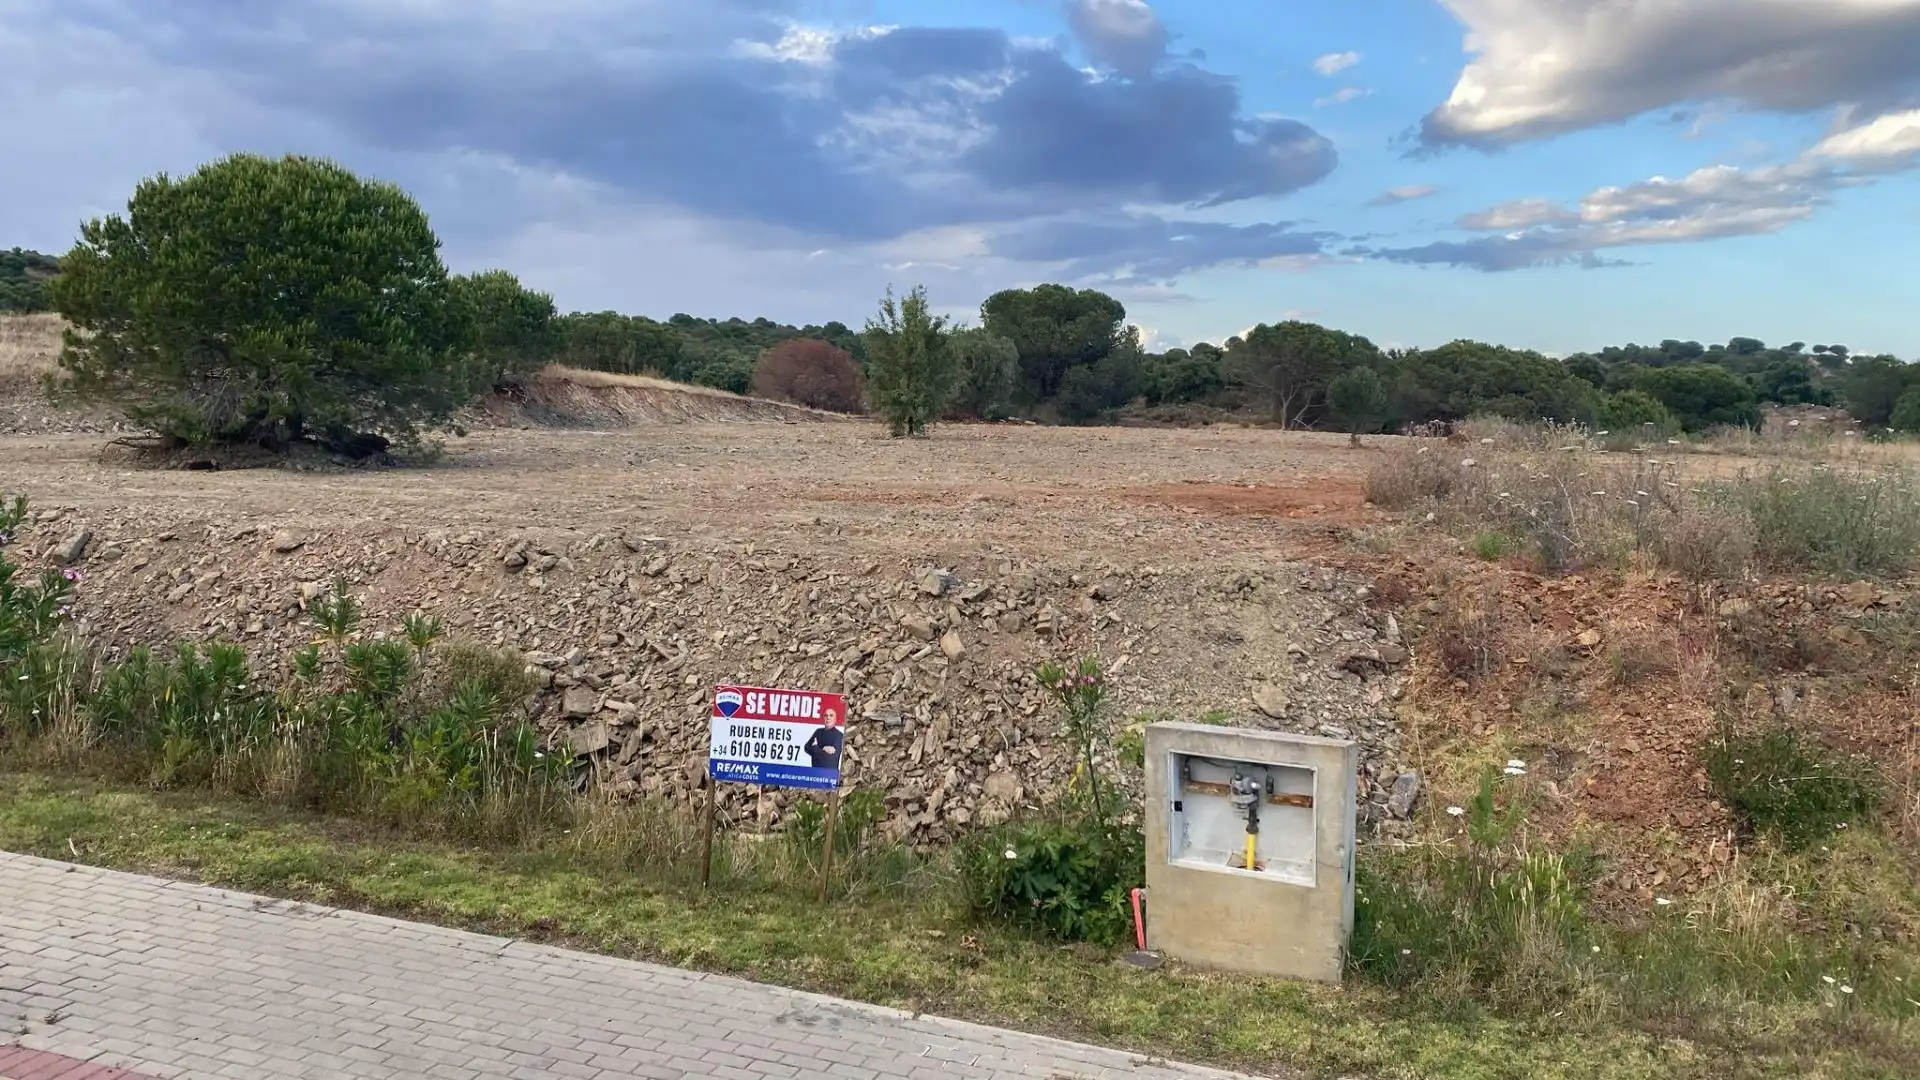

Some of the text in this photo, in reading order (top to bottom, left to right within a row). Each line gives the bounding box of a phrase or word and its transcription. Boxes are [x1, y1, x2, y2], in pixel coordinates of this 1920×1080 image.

[745, 691, 822, 719] SE VENDE
[729, 724, 792, 741] RUBEN REIS
[713, 740, 800, 762] +34 610 99 62 97
[717, 762, 759, 775] RE/MAX
